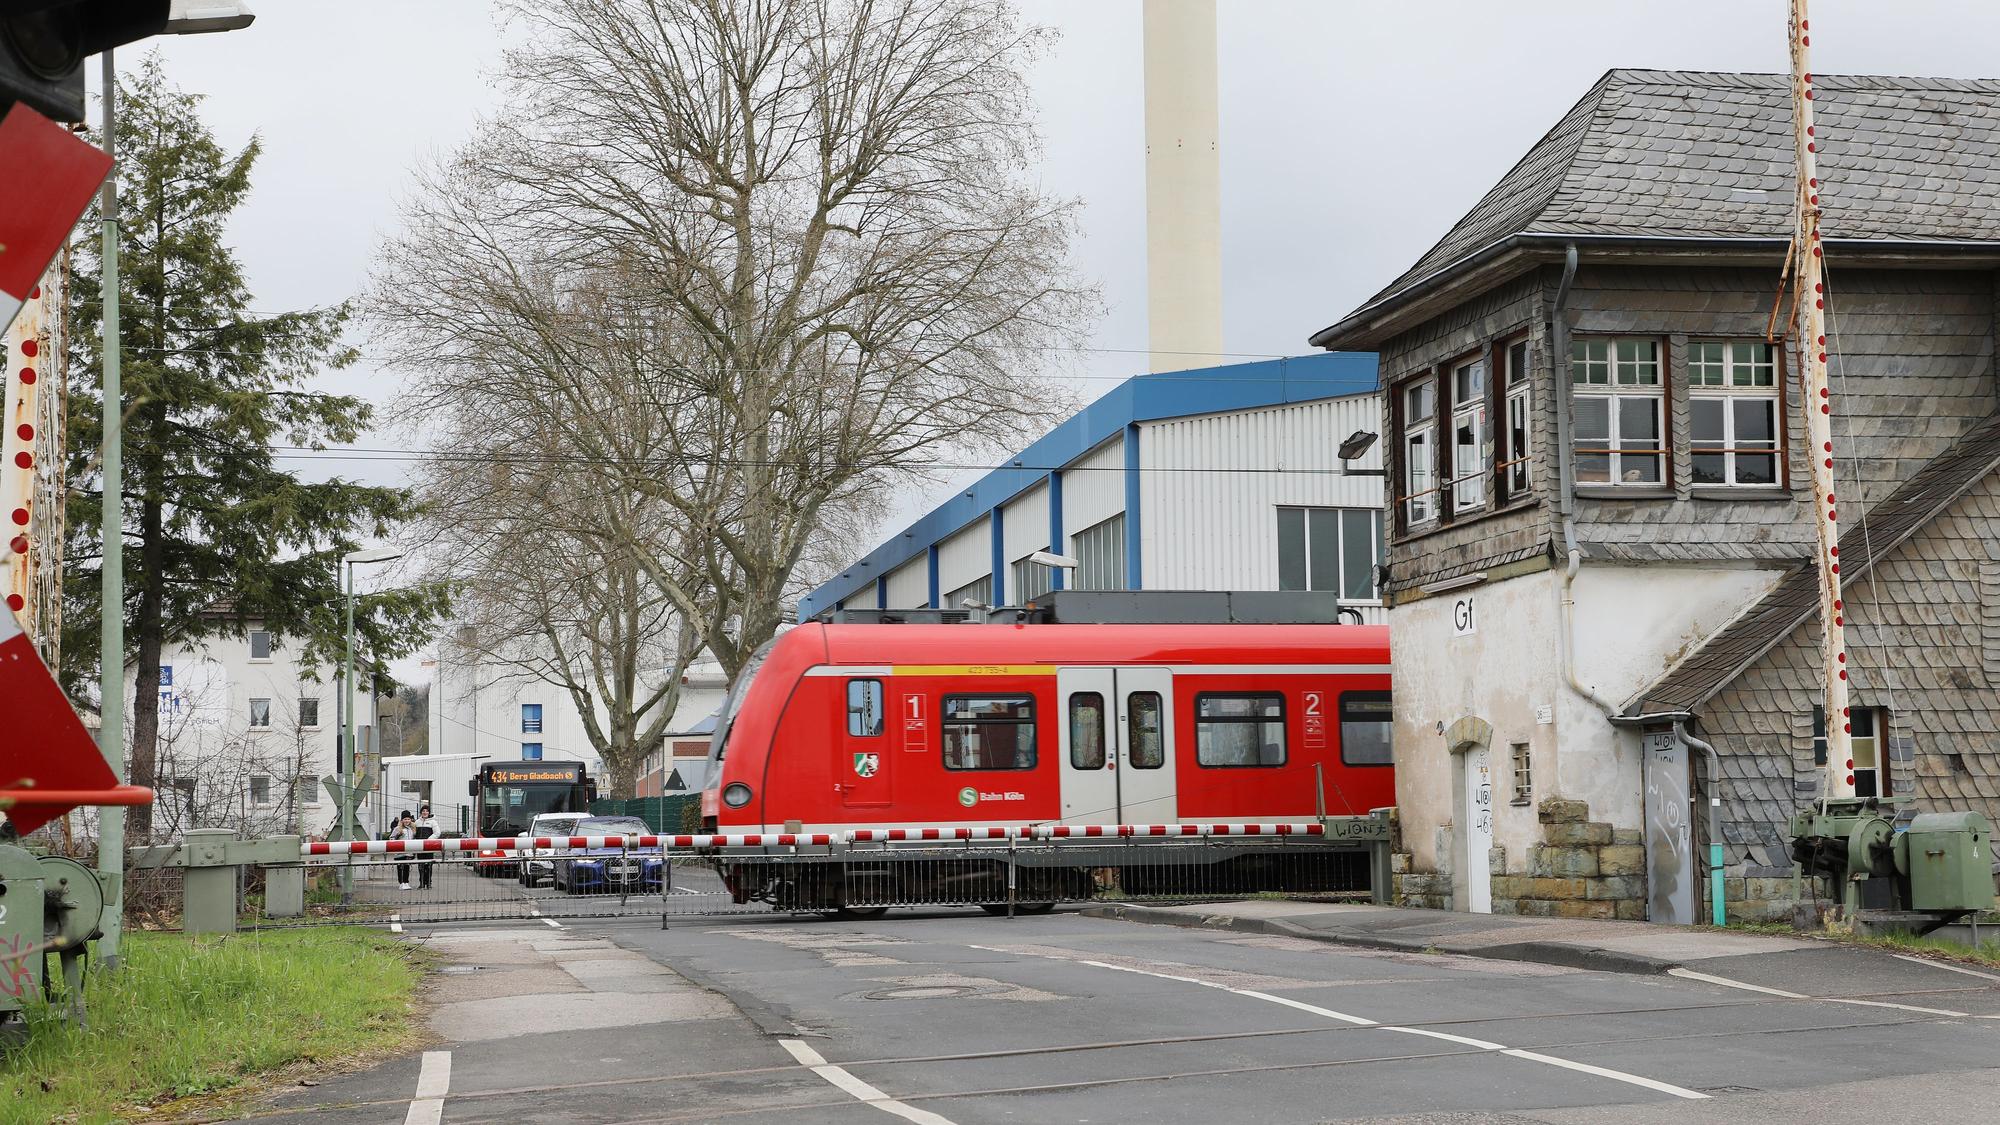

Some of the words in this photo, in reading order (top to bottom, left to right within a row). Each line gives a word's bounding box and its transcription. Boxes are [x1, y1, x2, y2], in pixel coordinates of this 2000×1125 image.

[1455, 597, 1473, 631] Gf
[908, 696, 919, 718] 1
[1306, 693, 1320, 715] 2
[491, 771, 507, 783] 434
[509, 772, 528, 781] Berg
[529, 772, 563, 780] Gladbach
[961, 788, 976, 806] S
[979, 792, 1003, 801] Bahn
[1004, 791, 1025, 801] Köln
[1973, 846, 1979, 859] 4
